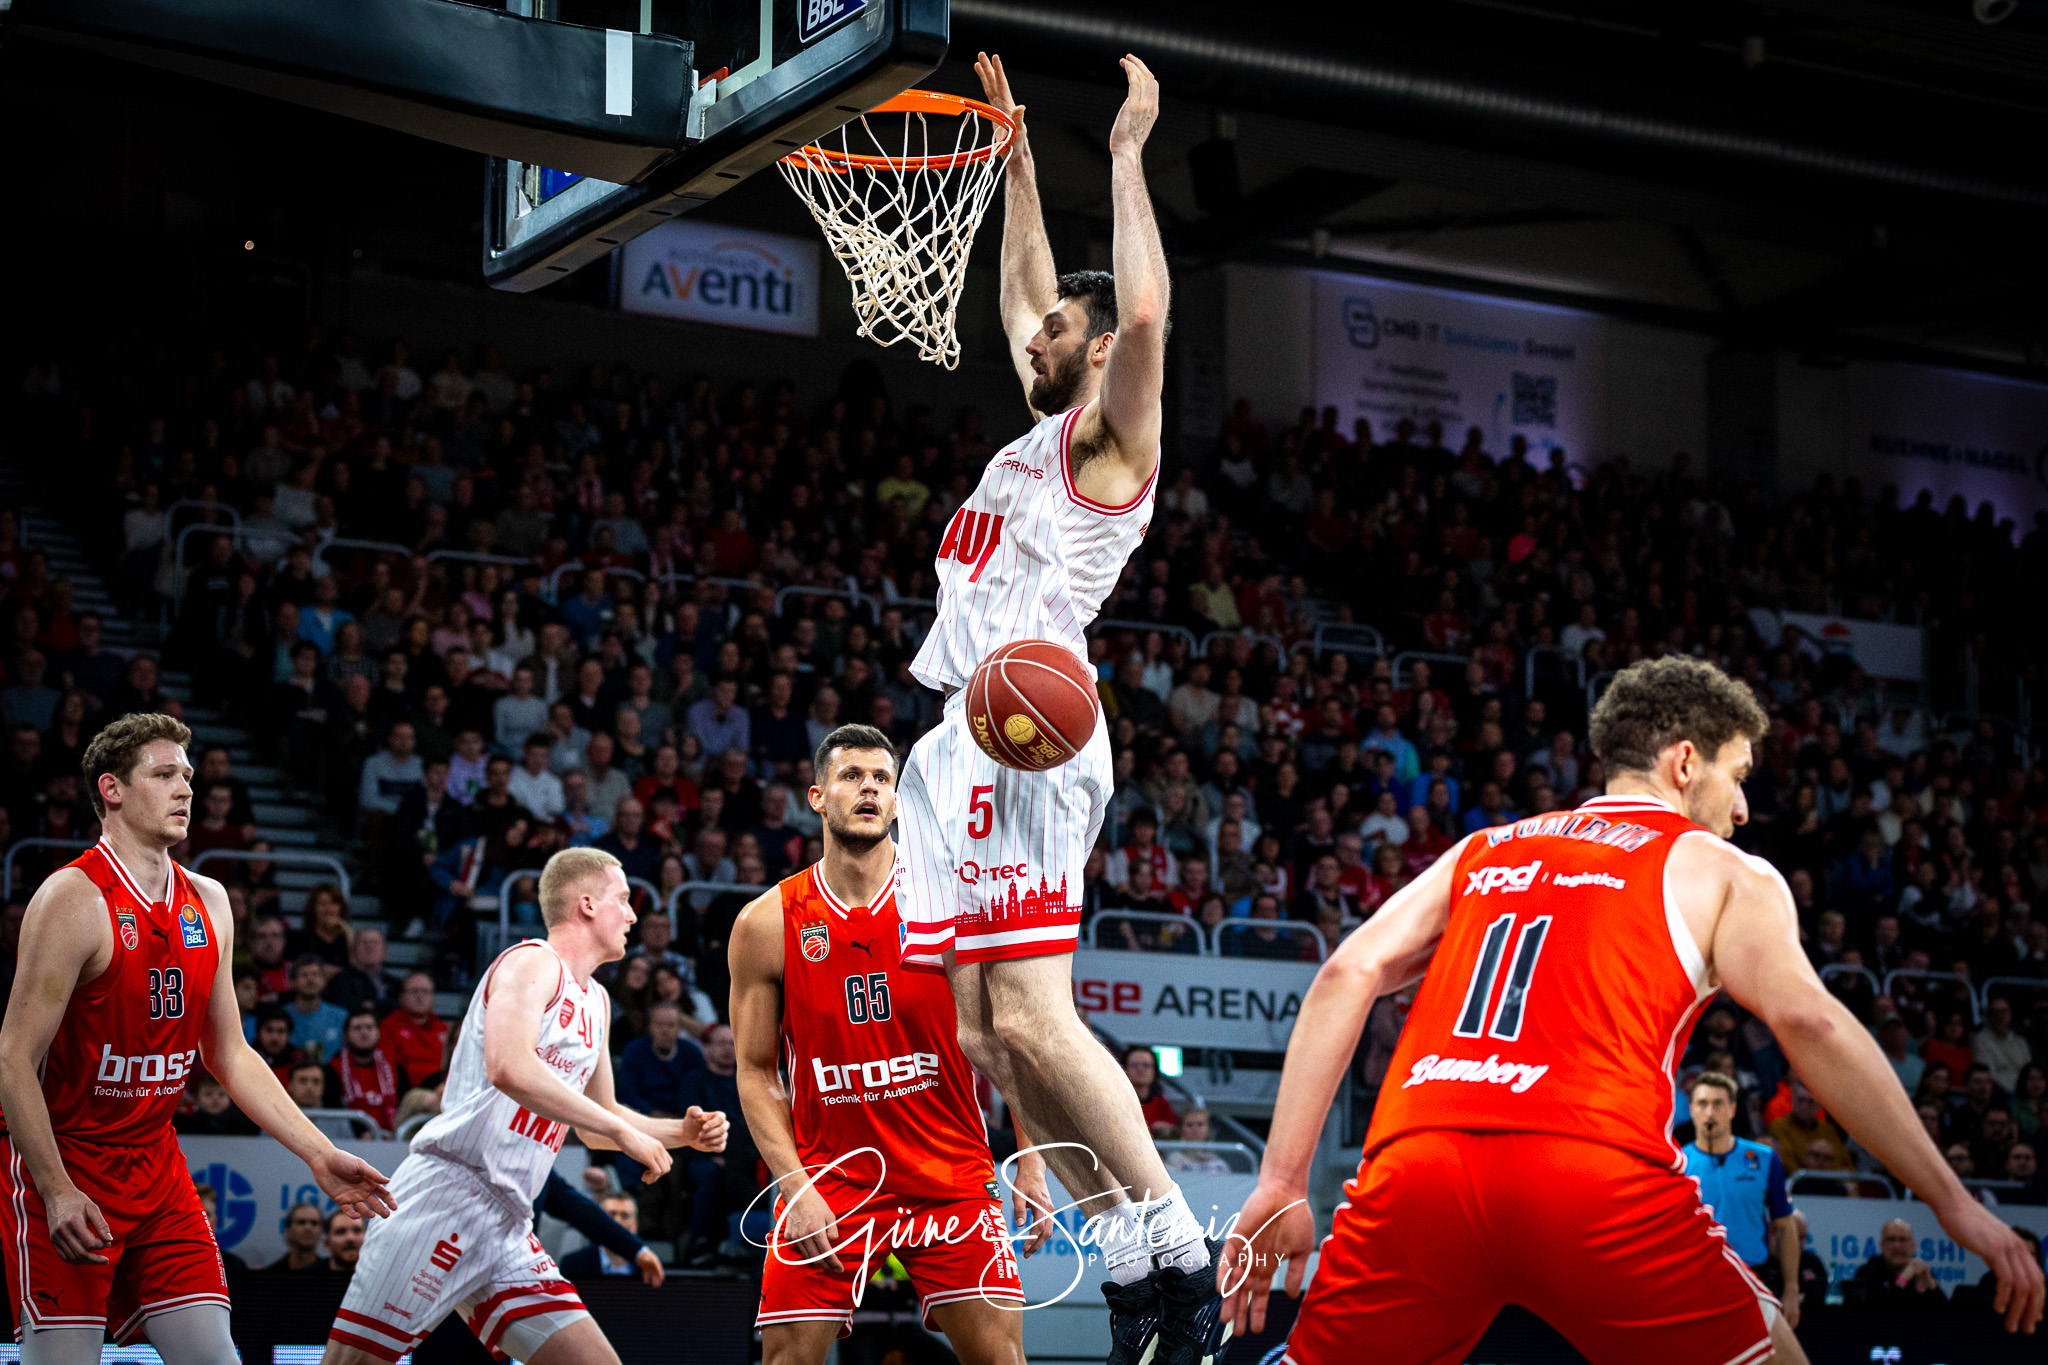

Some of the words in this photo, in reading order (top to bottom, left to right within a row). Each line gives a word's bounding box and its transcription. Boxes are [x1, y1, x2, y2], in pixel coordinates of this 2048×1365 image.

[642, 261, 793, 314] Aventi
[968, 784, 994, 840] 5
[1464, 860, 1543, 896] xpd
[1553, 872, 1626, 890] logistics
[186, 934, 204, 944] BBL
[149, 967, 184, 1020] 33
[1452, 913, 1553, 1042] 11
[845, 972, 892, 1024] 65
[1153, 984, 1301, 1023] ARENA
[93, 1085, 134, 1098] Technik
[135, 1086, 151, 1097] für
[811, 1052, 939, 1093] brose
[821, 1091, 862, 1106] Technik
[863, 1092, 880, 1102] für
[883, 1078, 939, 1100] Automobile
[1402, 1054, 1549, 1093] Bamberg
